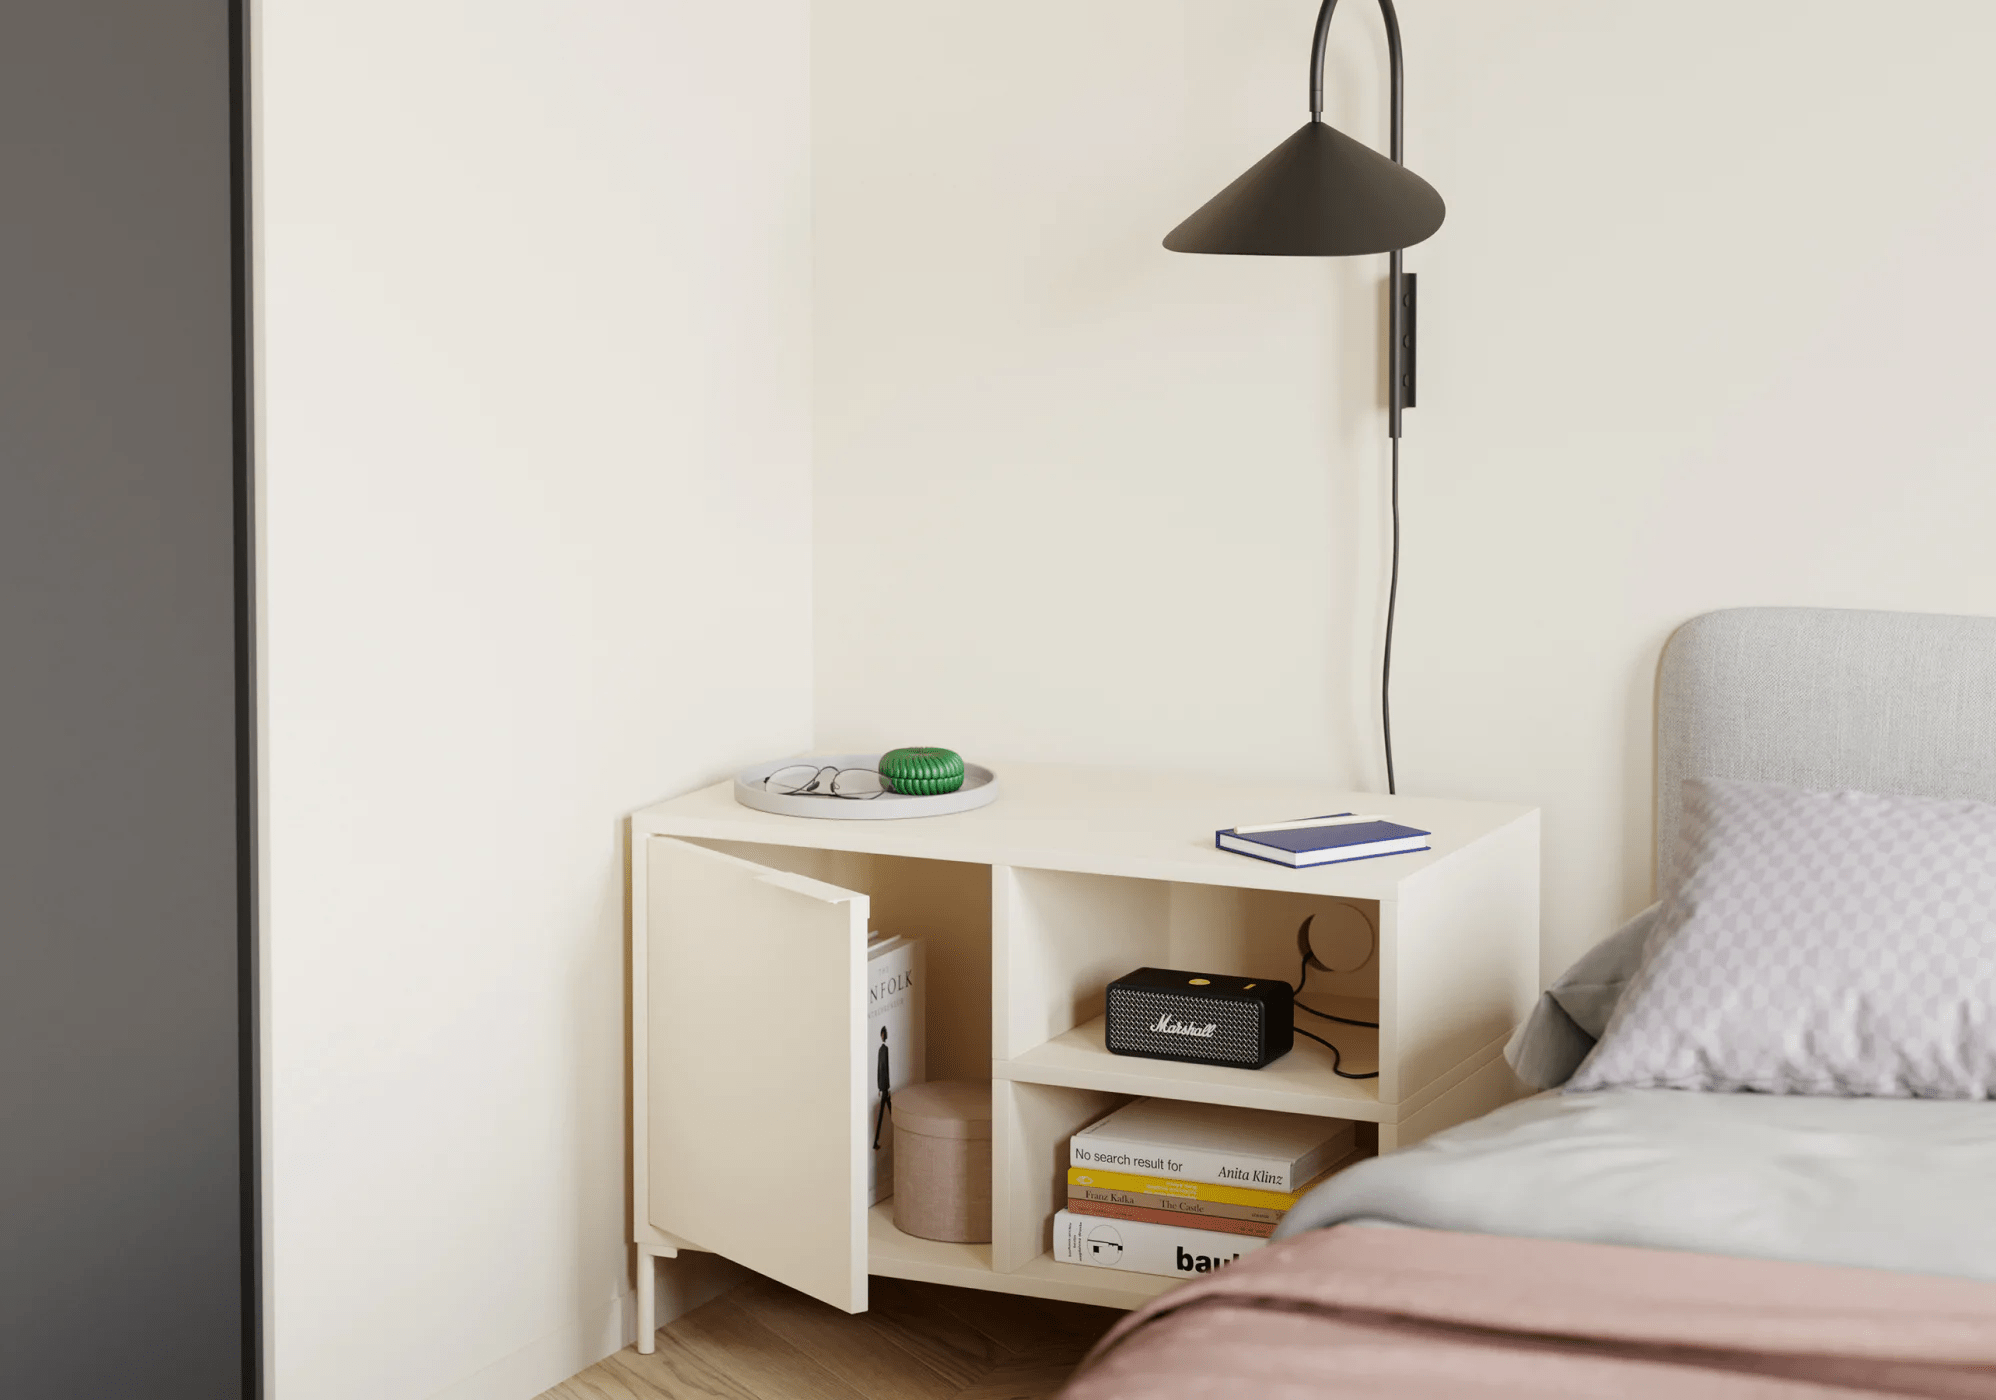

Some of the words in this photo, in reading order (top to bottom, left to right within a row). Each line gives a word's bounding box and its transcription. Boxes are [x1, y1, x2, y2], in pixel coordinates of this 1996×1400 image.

[869, 969, 913, 1004] NFOLK
[1150, 1013, 1217, 1038] Marshall
[1075, 1148, 1091, 1161] No
[1093, 1151, 1131, 1166] search
[1133, 1156, 1164, 1171] result
[1167, 1159, 1183, 1173] for
[1218, 1166, 1249, 1181] Anita
[1252, 1170, 1283, 1185] Klinz
[1085, 1190, 1108, 1202] Franz
[1110, 1193, 1135, 1205] Kafka
[1160, 1199, 1178, 1210] The
[1179, 1202, 1204, 1213] Castle
